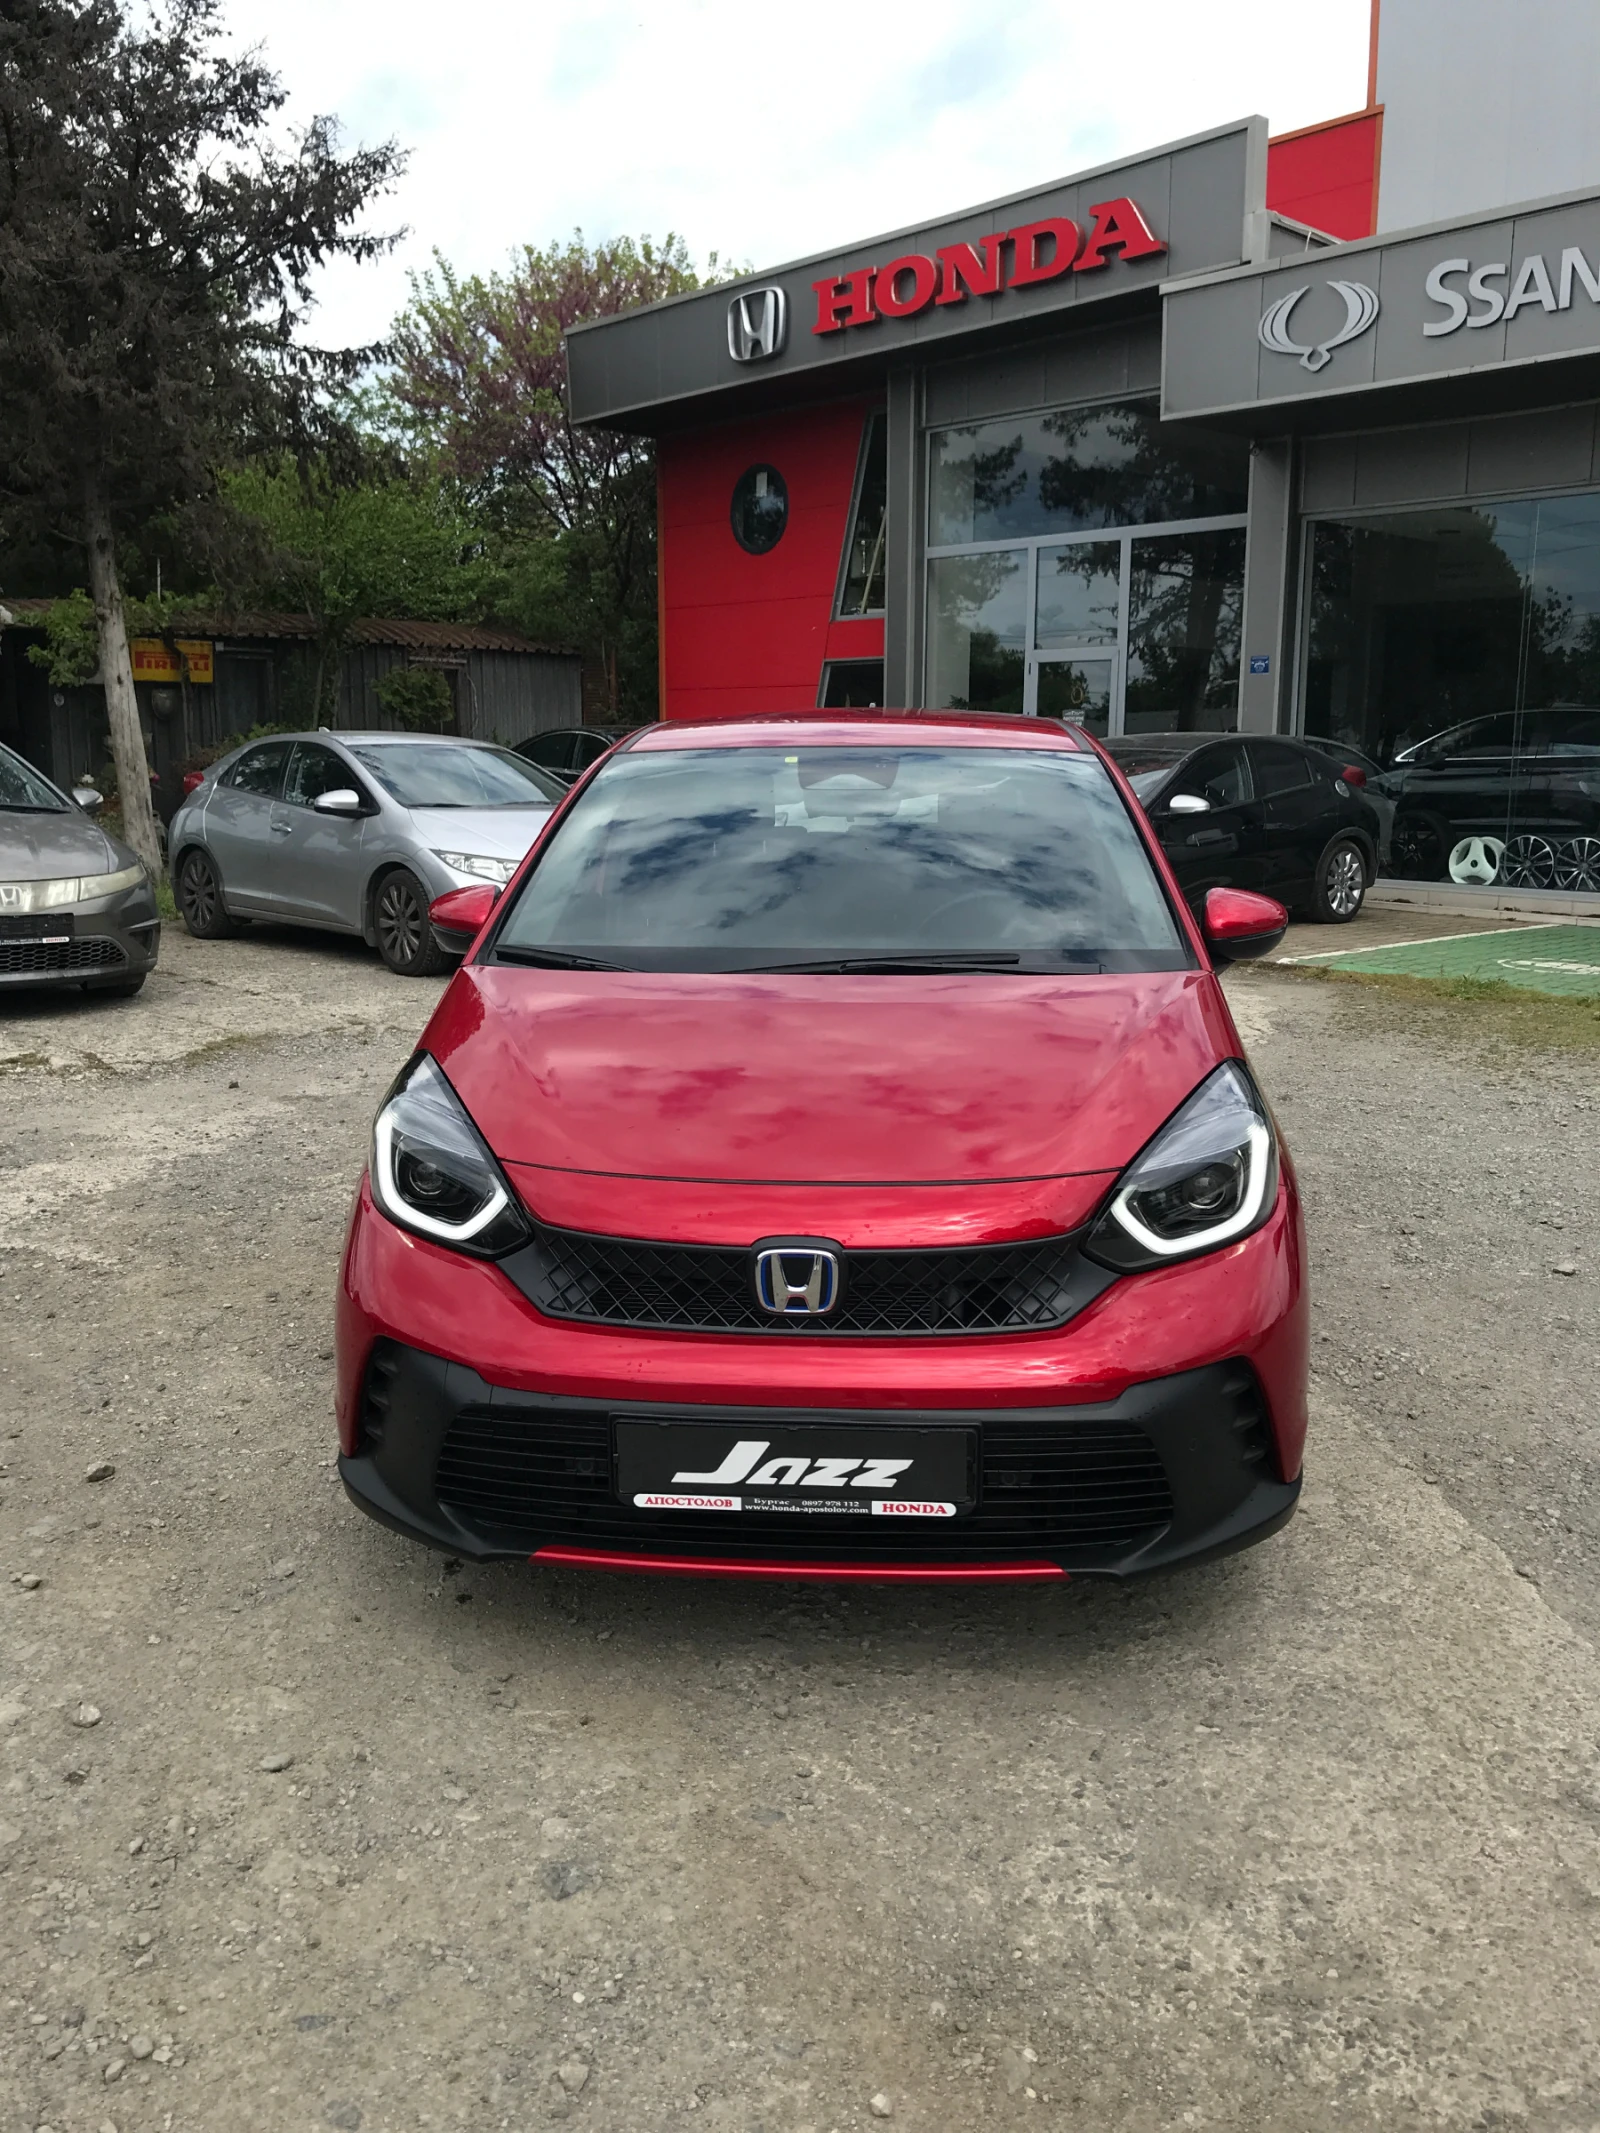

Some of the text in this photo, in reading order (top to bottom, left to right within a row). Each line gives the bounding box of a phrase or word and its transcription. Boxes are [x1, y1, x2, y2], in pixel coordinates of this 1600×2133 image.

[811, 196, 1168, 336] HONDA
[1423, 246, 1600, 337] SSAN
[645, 1496, 733, 1508] АПОСТОЛОВ
[754, 1498, 790, 1506] Бургас
[745, 1503, 869, 1514] www.honda-apostolov.com
[882, 1503, 948, 1515] HONDA
